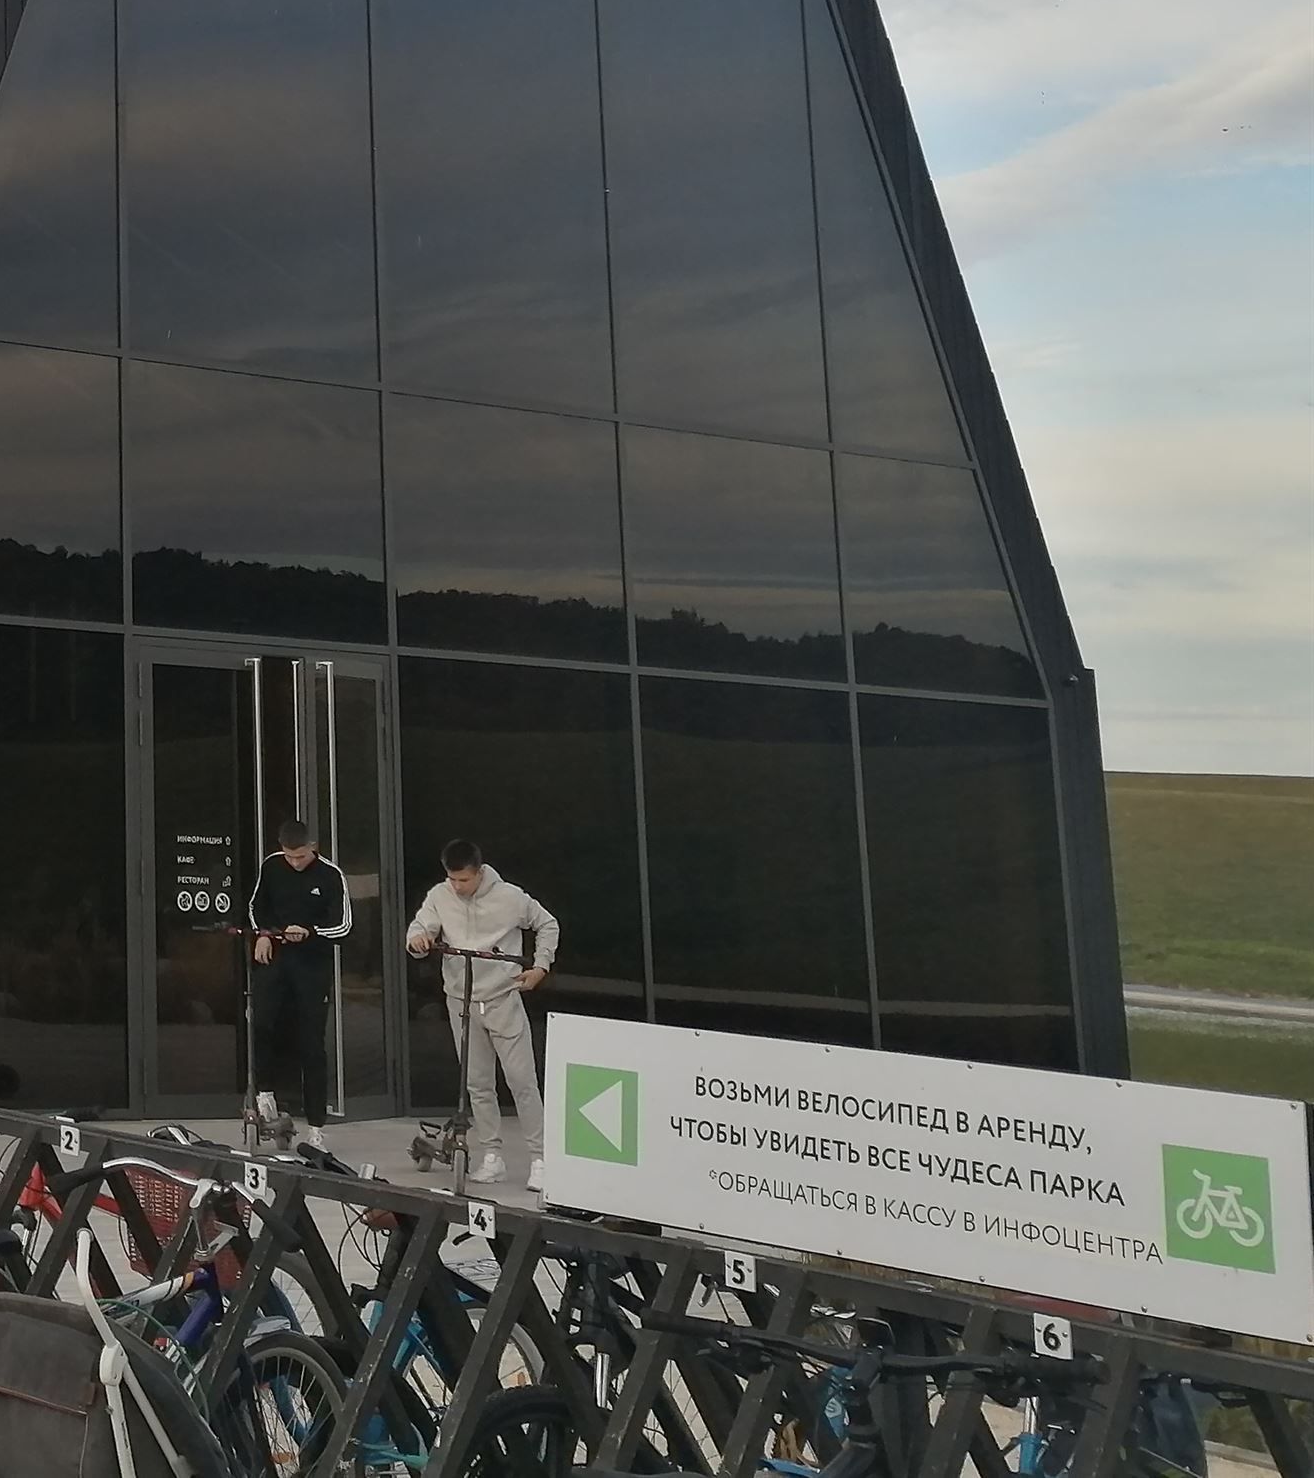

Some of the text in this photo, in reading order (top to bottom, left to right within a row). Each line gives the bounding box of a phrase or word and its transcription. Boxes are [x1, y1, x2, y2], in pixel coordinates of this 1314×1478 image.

[177, 875, 210, 885] РЕСТОРАН
[695, 1075, 1092, 1154] ВОЗЬМИ ВЕЛОСИПЕД В АРЕНДУ,
[64, 1130, 74, 1151] 2
[670, 1115, 1125, 1207] ЧТОБЫ УВИДЕТЬ ВСЕ ЧУДЕСА ПАРКА
[249, 1167, 260, 1190] 3
[473, 1208, 487, 1232] 4
[865, 1194, 877, 1215] В
[883, 1197, 956, 1227] КАССУ
[963, 1211, 976, 1232] В
[984, 1214, 1164, 1265] ИНФОЦЕНТРА
[731, 1258, 745, 1285] 5
[1042, 1322, 1062, 1352] 6
